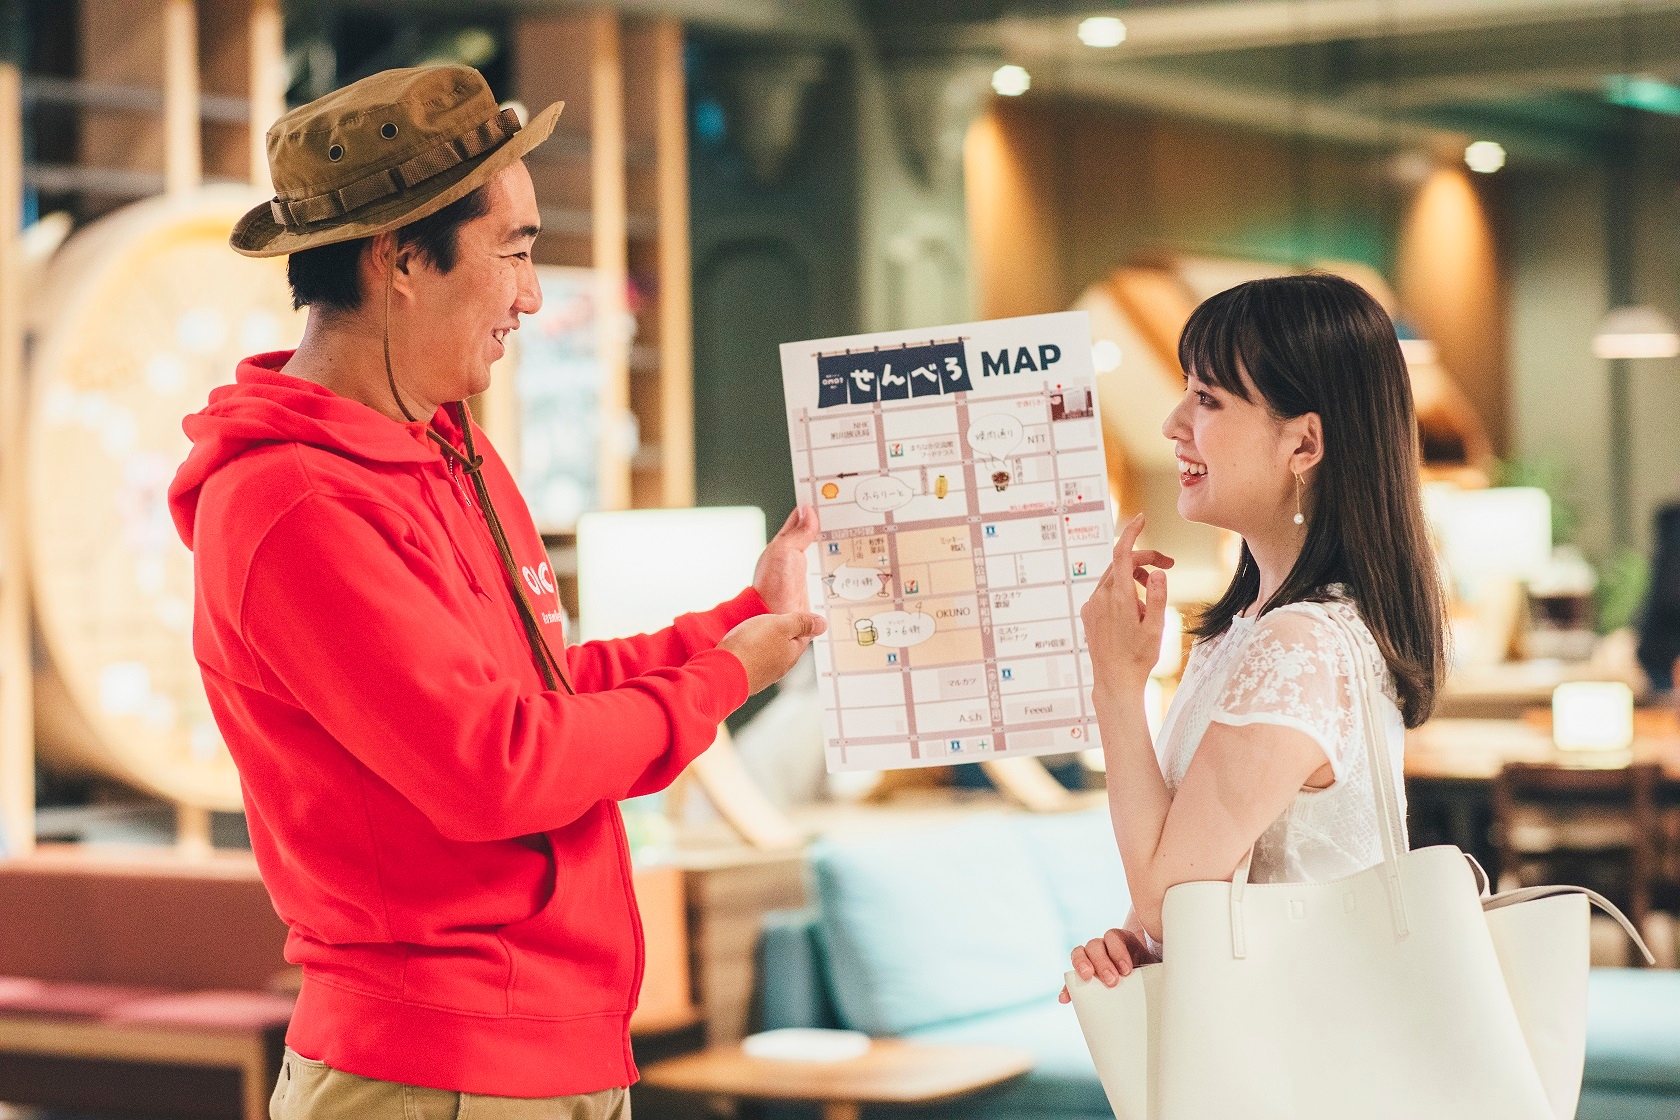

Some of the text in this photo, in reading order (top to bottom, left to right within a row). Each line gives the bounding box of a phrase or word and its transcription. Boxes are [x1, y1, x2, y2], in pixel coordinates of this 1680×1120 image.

[851, 343, 1062, 393] せんべろ MAP
[1027, 434, 1045, 444] NTT
[935, 607, 971, 619] OKUNO
